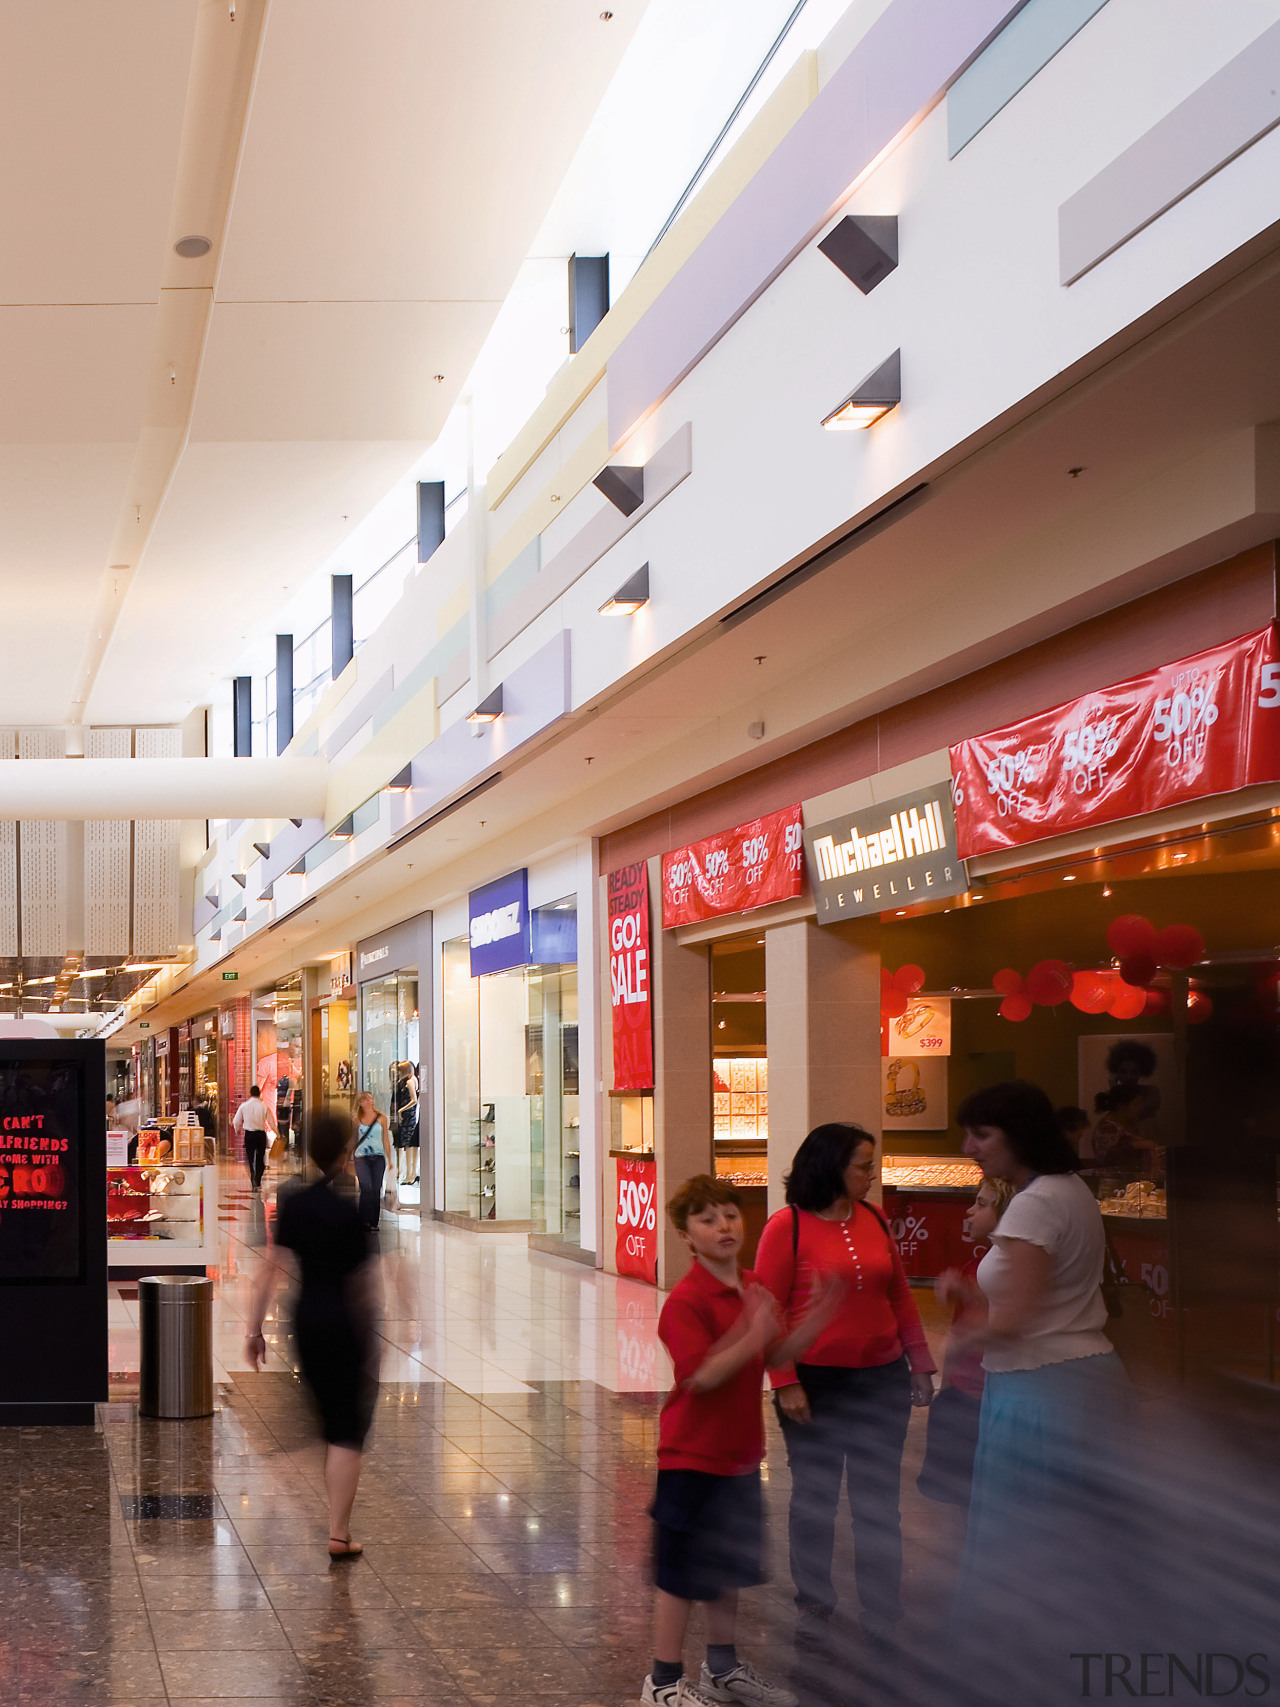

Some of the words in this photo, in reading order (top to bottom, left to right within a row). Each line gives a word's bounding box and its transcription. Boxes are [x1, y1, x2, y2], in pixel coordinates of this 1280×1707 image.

[1171, 674, 1185, 687] UP
[1186, 667, 1200, 681] TO
[1153, 681, 1219, 742] 50%
[1063, 715, 1118, 771] 50%
[1167, 732, 1205, 767] OFF
[987, 745, 1035, 794] 50%
[1073, 763, 1109, 795] OFF
[997, 789, 1027, 817] OFF
[705, 847, 729, 879] 50%
[742, 833, 769, 867] 50%
[609, 862, 645, 894] READY
[669, 859, 693, 889] 50%
[710, 876, 724, 896] OFF
[746, 865, 763, 885] OFF
[825, 866, 953, 911] JEWELLER
[609, 888, 645, 916] STEADY
[673, 887, 689, 905] OFF
[611, 912, 641, 952] GO!
[610, 949, 648, 1007] SALE
[919, 1038, 943, 1048] $399
[3, 1115, 44, 1130] CAN'T
[31, 1154, 59, 1165] WITH
[11, 1199, 68, 1210] SHOPPING?
[616, 1180, 656, 1231] 50%
[888, 1216, 929, 1240] 0%
[625, 1234, 646, 1258] OFF
[897, 1241, 918, 1256] FF
